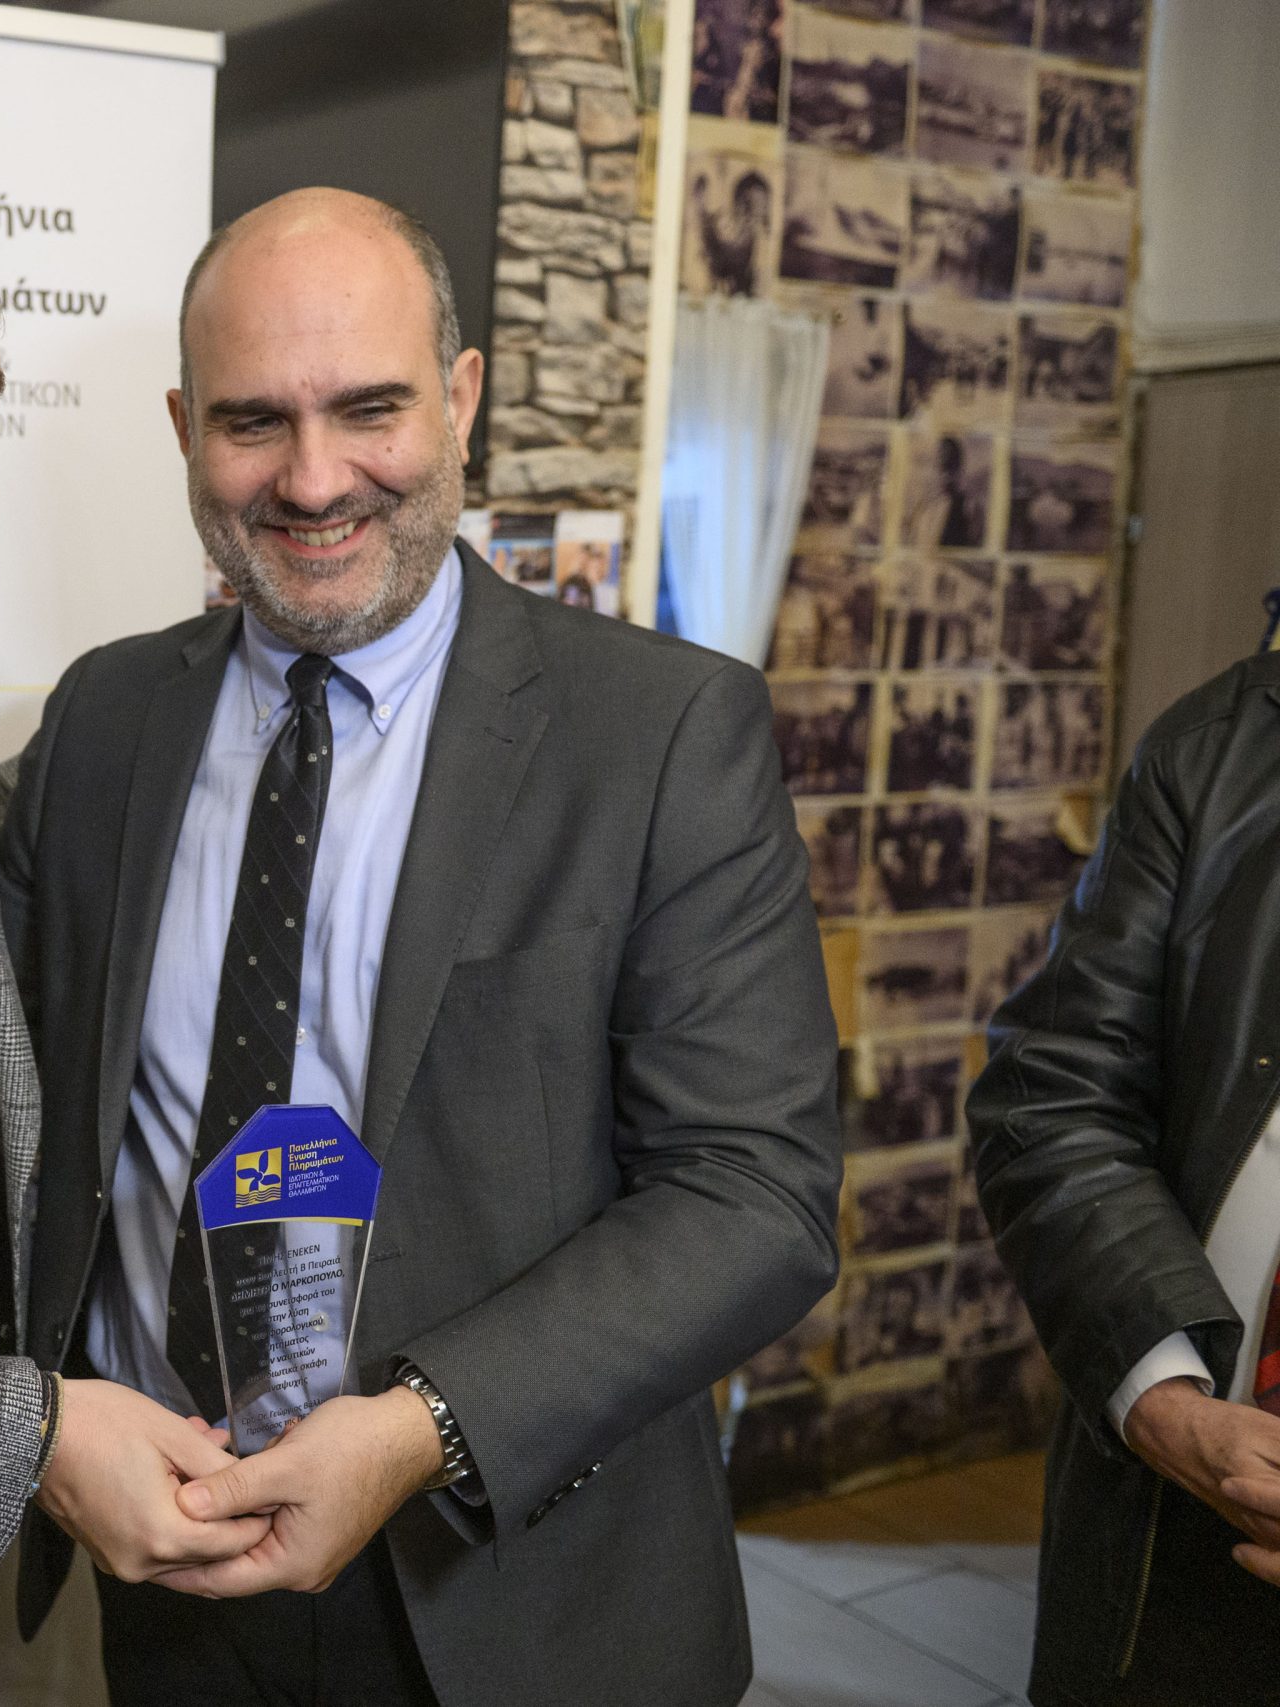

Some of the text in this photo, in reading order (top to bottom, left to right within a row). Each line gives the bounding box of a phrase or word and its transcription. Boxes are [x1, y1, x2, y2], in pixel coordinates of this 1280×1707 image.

[289, 1138, 338, 1153] Πανελλήνια
[288, 1151, 318, 1162] Ένωση
[289, 1155, 345, 1171] Πληρωμάτων
[287, 1244, 320, 1259] ΕΝΕΚΕΝ
[300, 1263, 306, 1273] Β
[308, 1255, 341, 1270] Πειραιά
[320, 1288, 335, 1297] του
[288, 1307, 309, 1319] λύση
[265, 1335, 309, 1352] ητήματος
[300, 1358, 327, 1371] σκάφη
